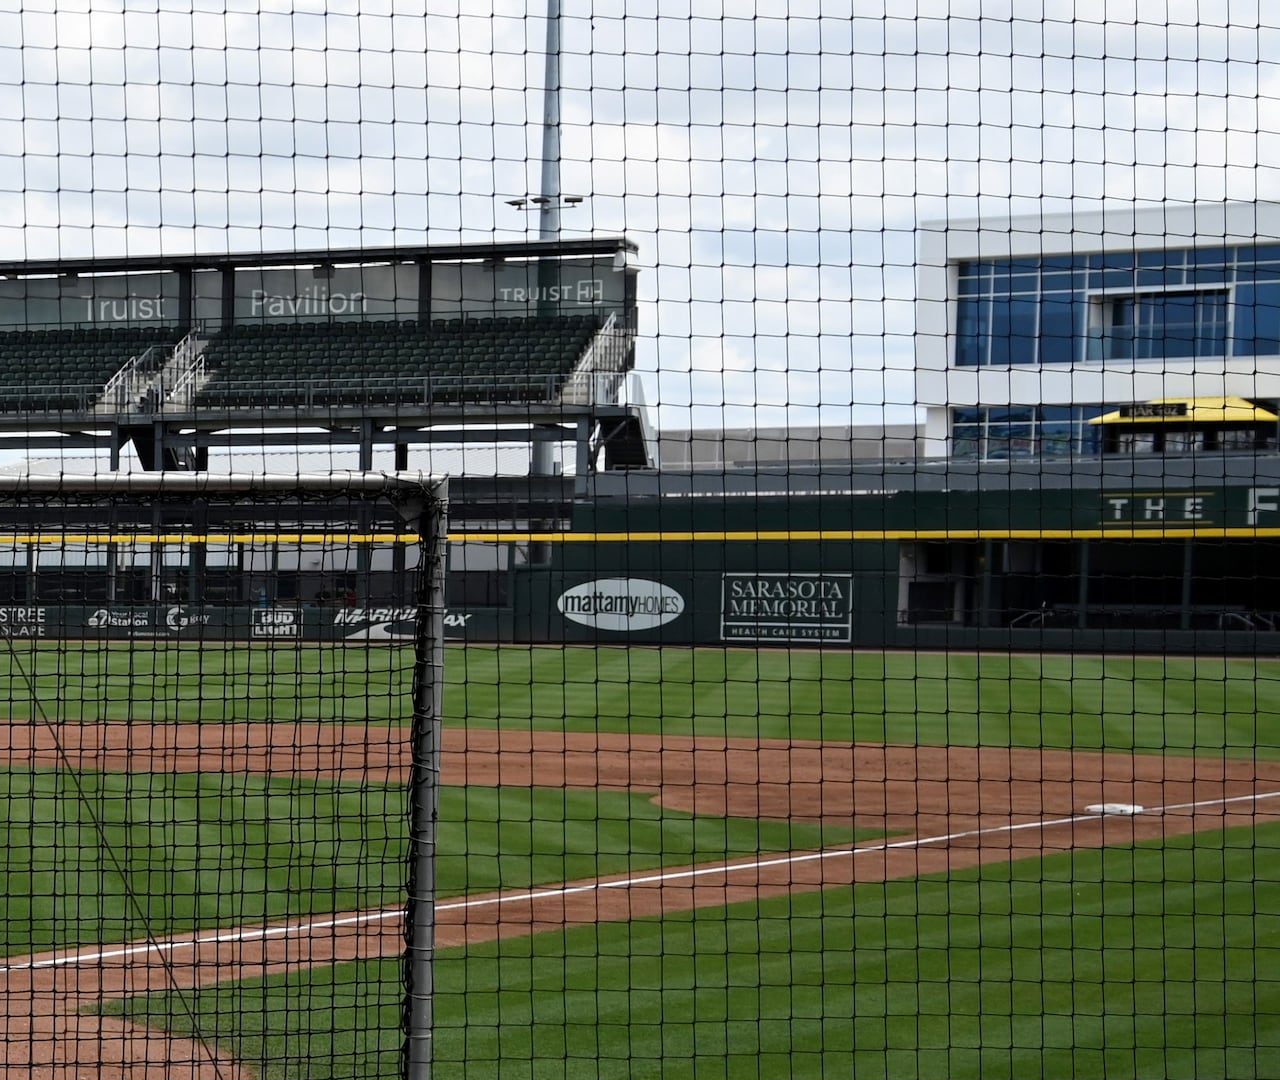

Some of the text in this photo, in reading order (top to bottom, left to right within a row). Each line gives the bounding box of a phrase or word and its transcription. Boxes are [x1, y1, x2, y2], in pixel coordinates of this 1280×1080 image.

[500, 285, 573, 303] TRUIST
[85, 288, 368, 321] Truist Pavilion
[1109, 498, 1204, 520] THE
[731, 580, 844, 599] SARASOTA
[730, 599, 843, 618] MEMORIAL
[111, 617, 149, 626] Station
[254, 624, 298, 635] LIGHT
[731, 627, 840, 638] HEALTH CARE SYSTEM
